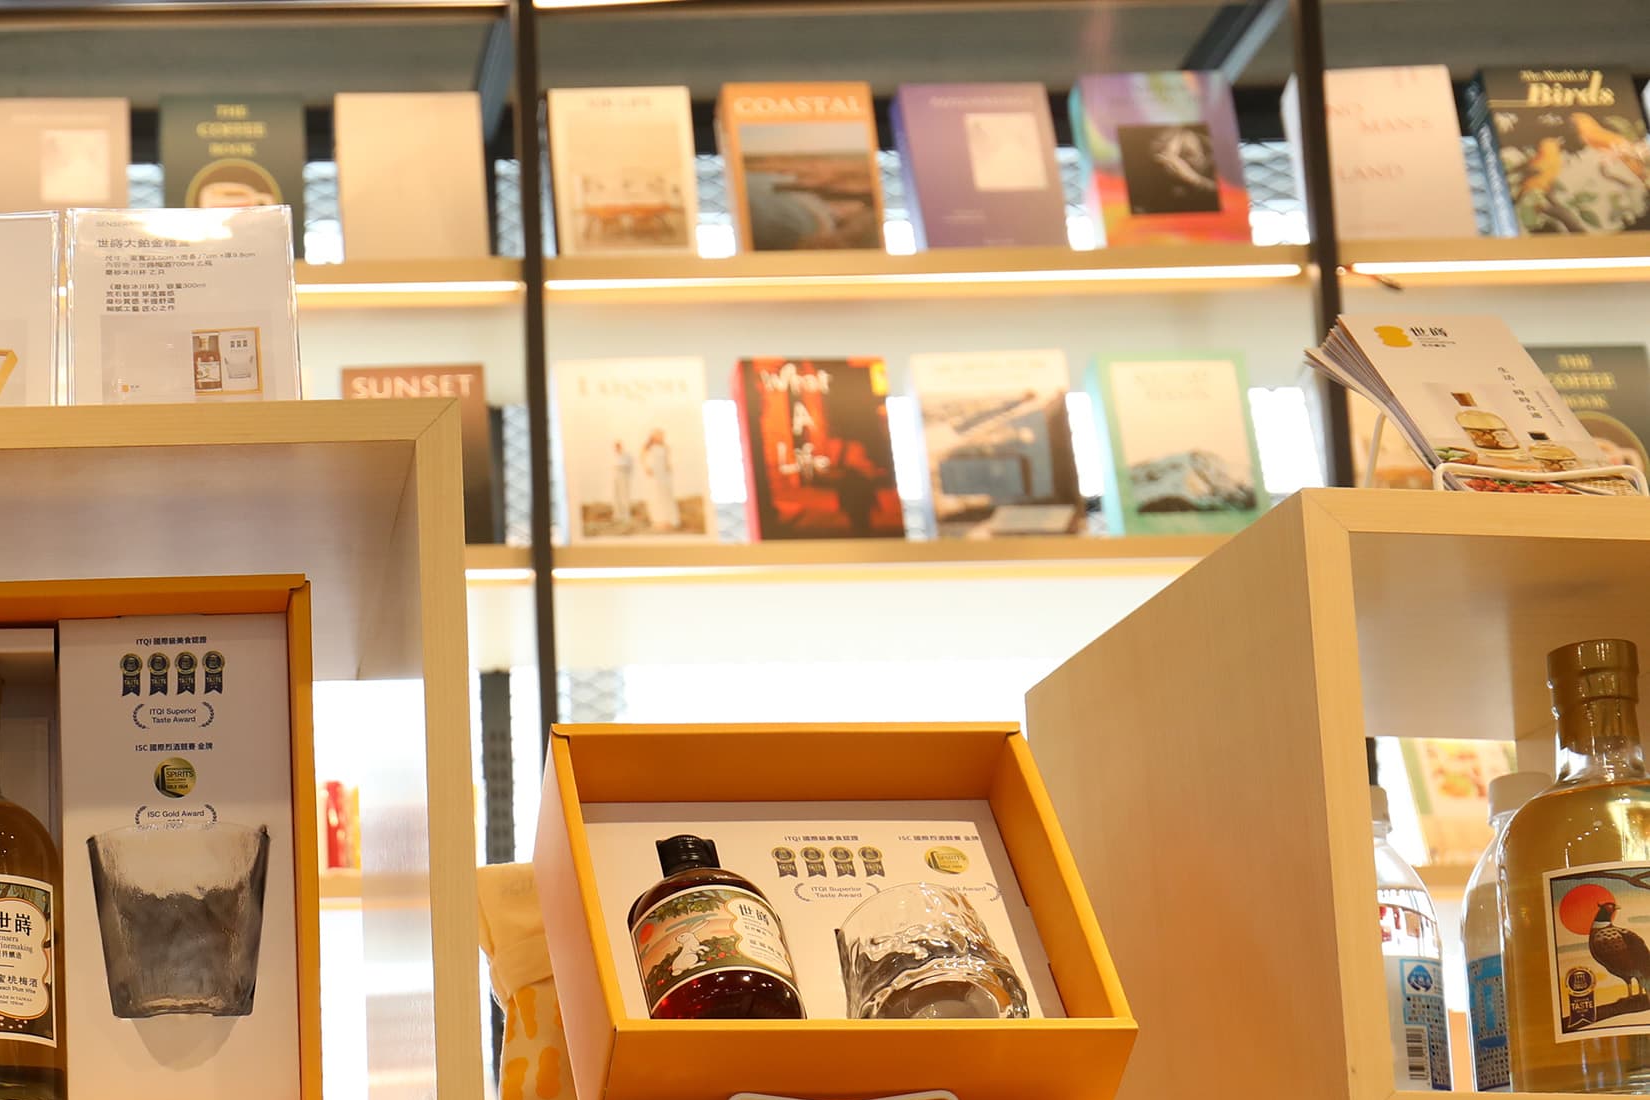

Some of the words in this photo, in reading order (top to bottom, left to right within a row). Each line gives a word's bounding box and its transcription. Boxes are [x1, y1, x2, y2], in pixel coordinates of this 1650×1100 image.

[1528, 71, 1615, 107] Birds
[734, 97, 863, 115] COASTAL
[352, 373, 474, 399] SUNSET
[759, 363, 832, 394] What
[793, 404, 813, 435] A
[777, 442, 829, 475] Life
[167, 708, 196, 716] Superior
[1571, 1001, 1593, 1009] TASTE
